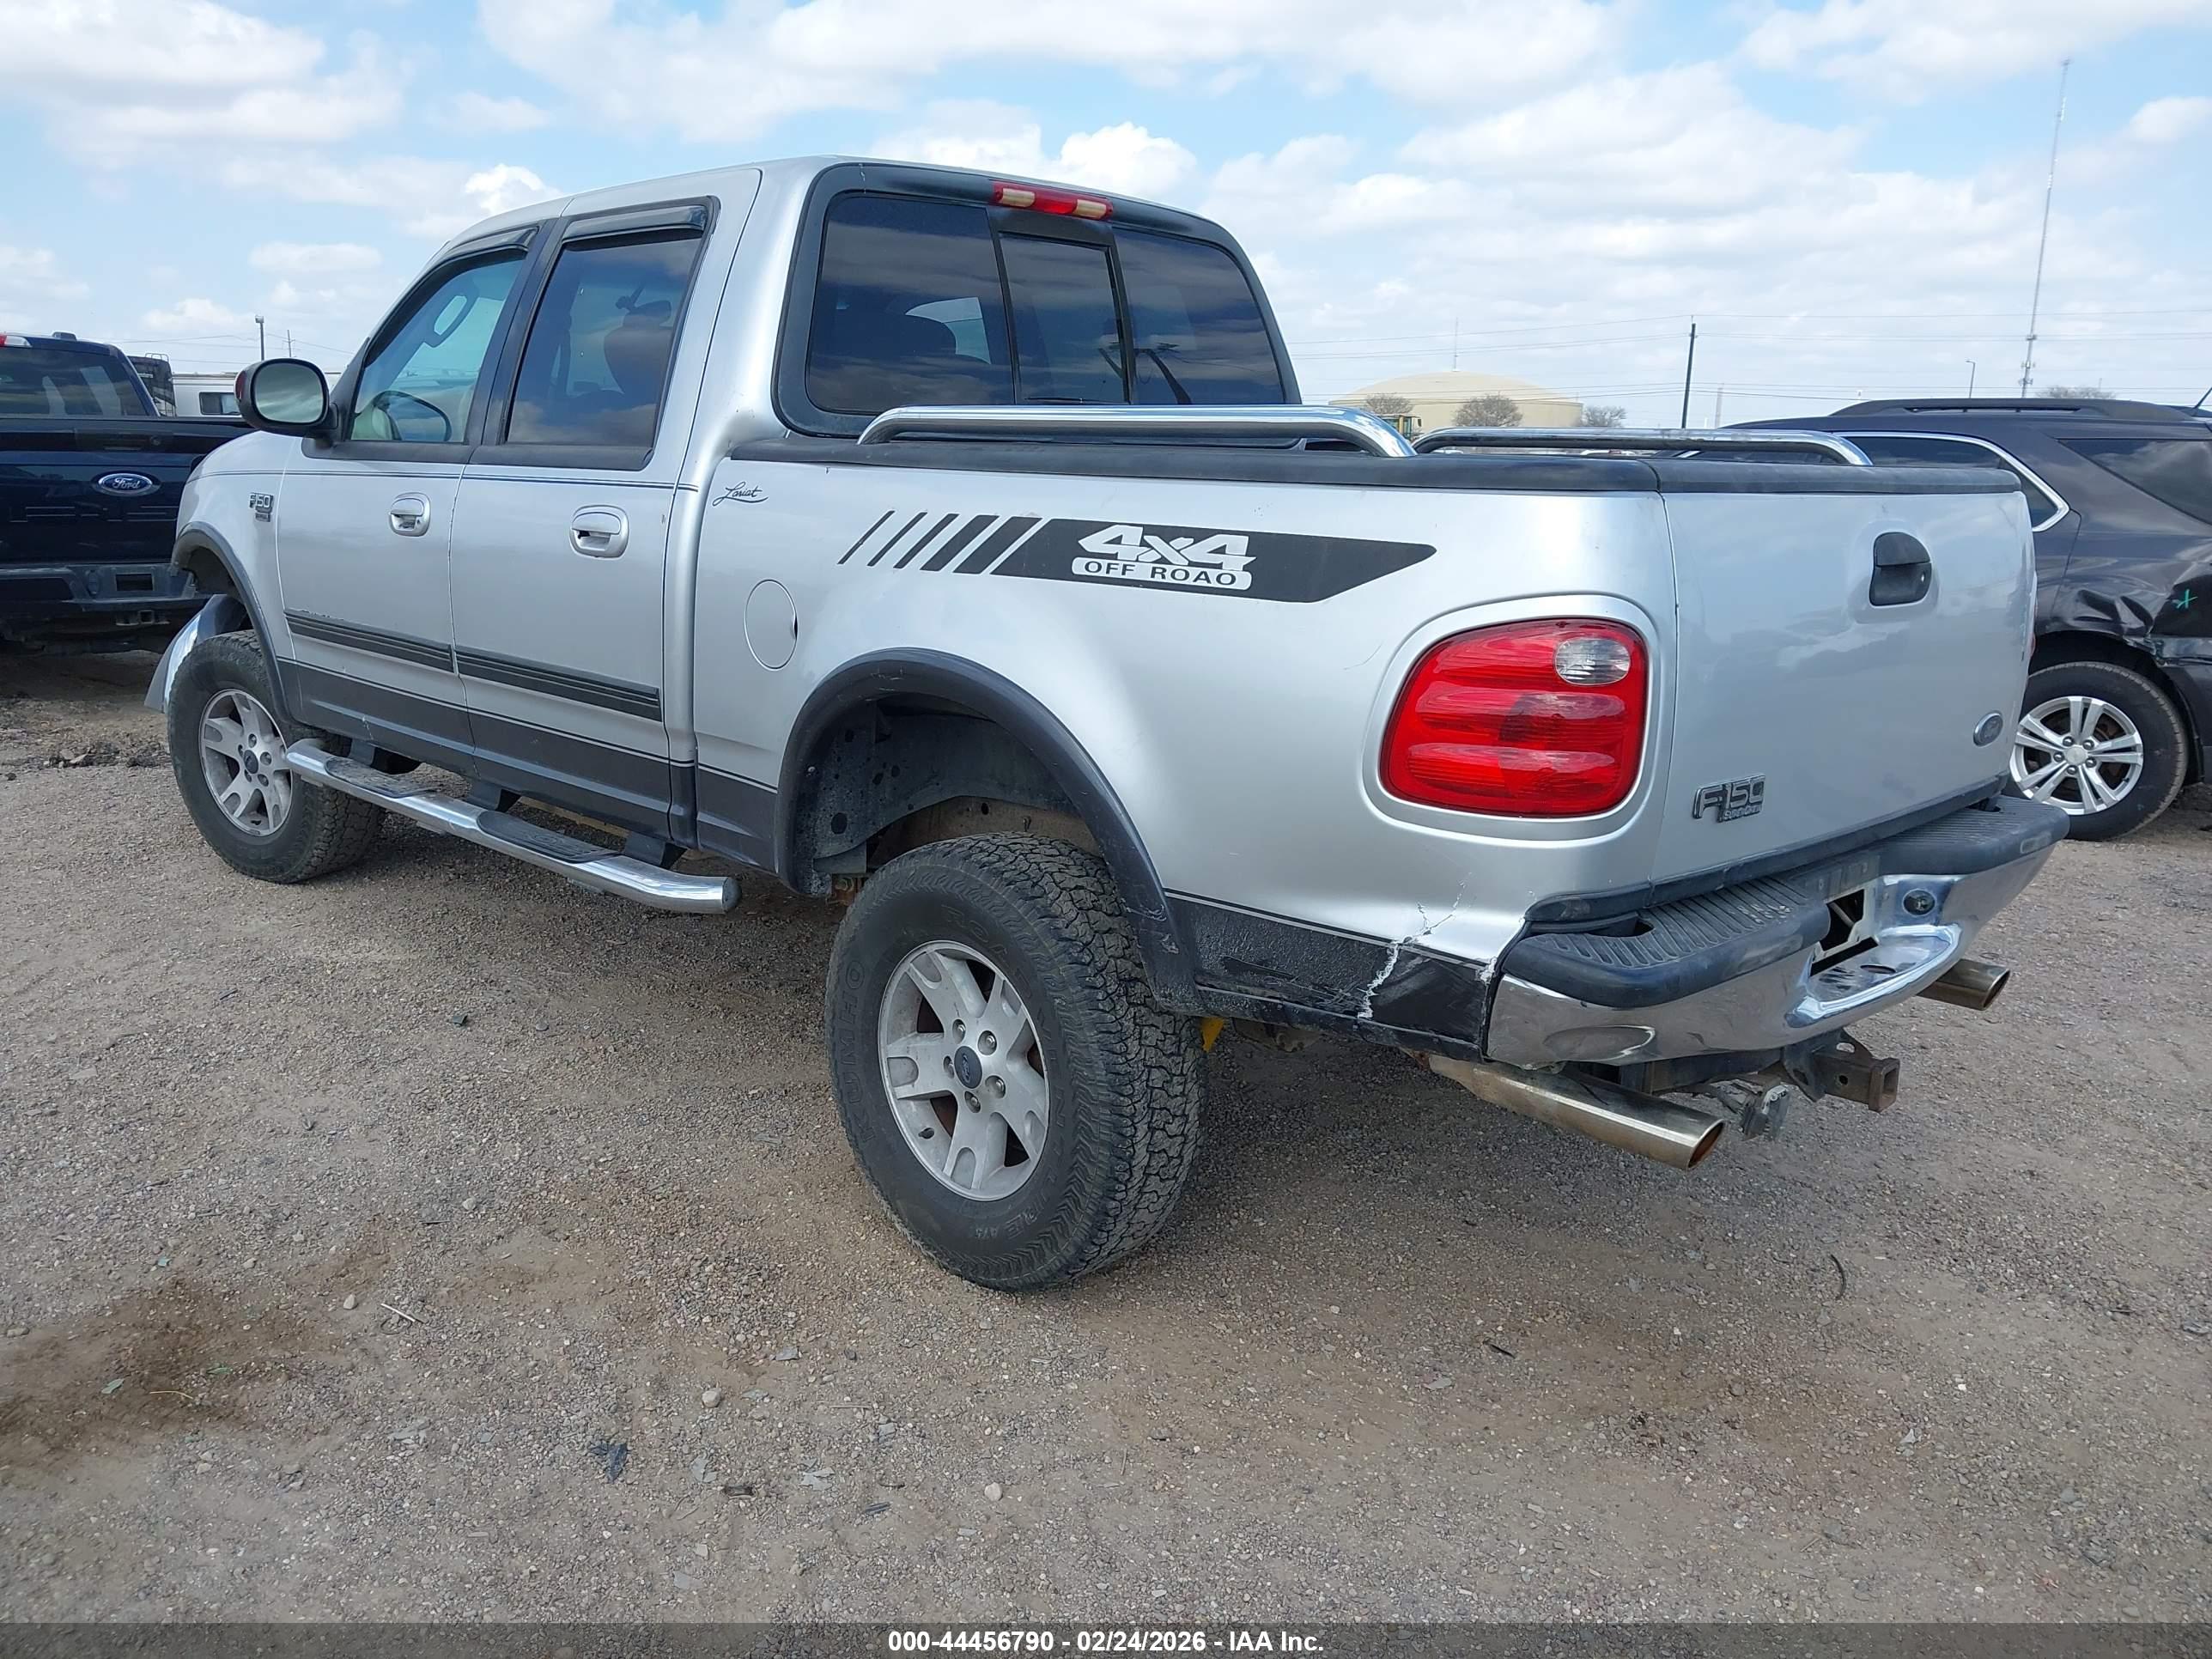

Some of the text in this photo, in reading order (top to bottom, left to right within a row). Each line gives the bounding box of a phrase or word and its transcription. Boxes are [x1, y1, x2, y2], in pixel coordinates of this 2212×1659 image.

[112, 477, 140, 489] Ford
[713, 481, 769, 507] Lariat
[1085, 561, 1135, 576] OFF
[836, 960, 874, 1142] KUMHO
